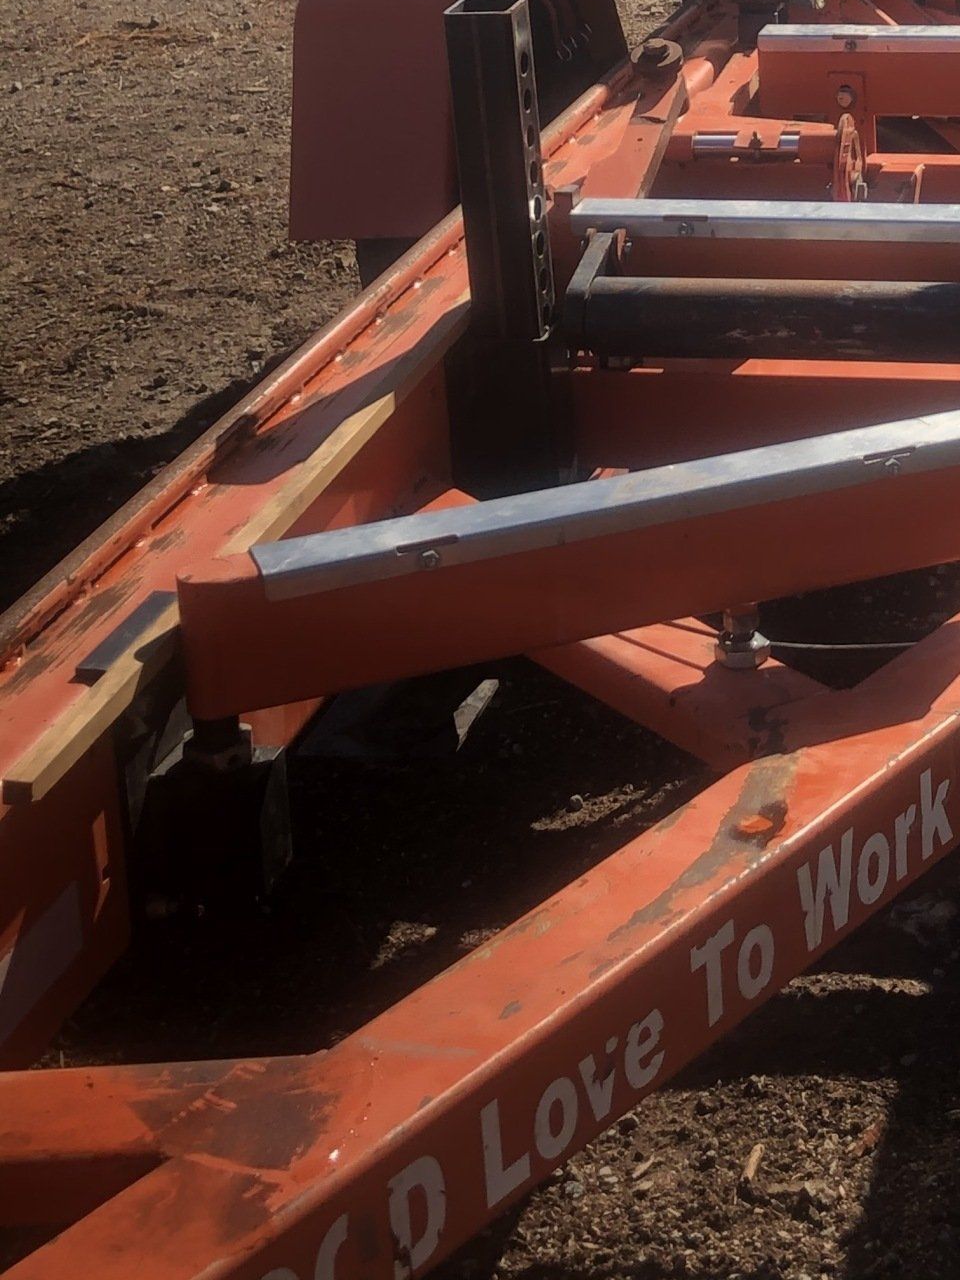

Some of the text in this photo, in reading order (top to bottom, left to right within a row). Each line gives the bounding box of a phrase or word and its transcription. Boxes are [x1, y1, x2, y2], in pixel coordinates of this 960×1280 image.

[479, 1009, 666, 1209] Love
[690, 920, 775, 1027] To
[797, 769, 955, 952] Work
